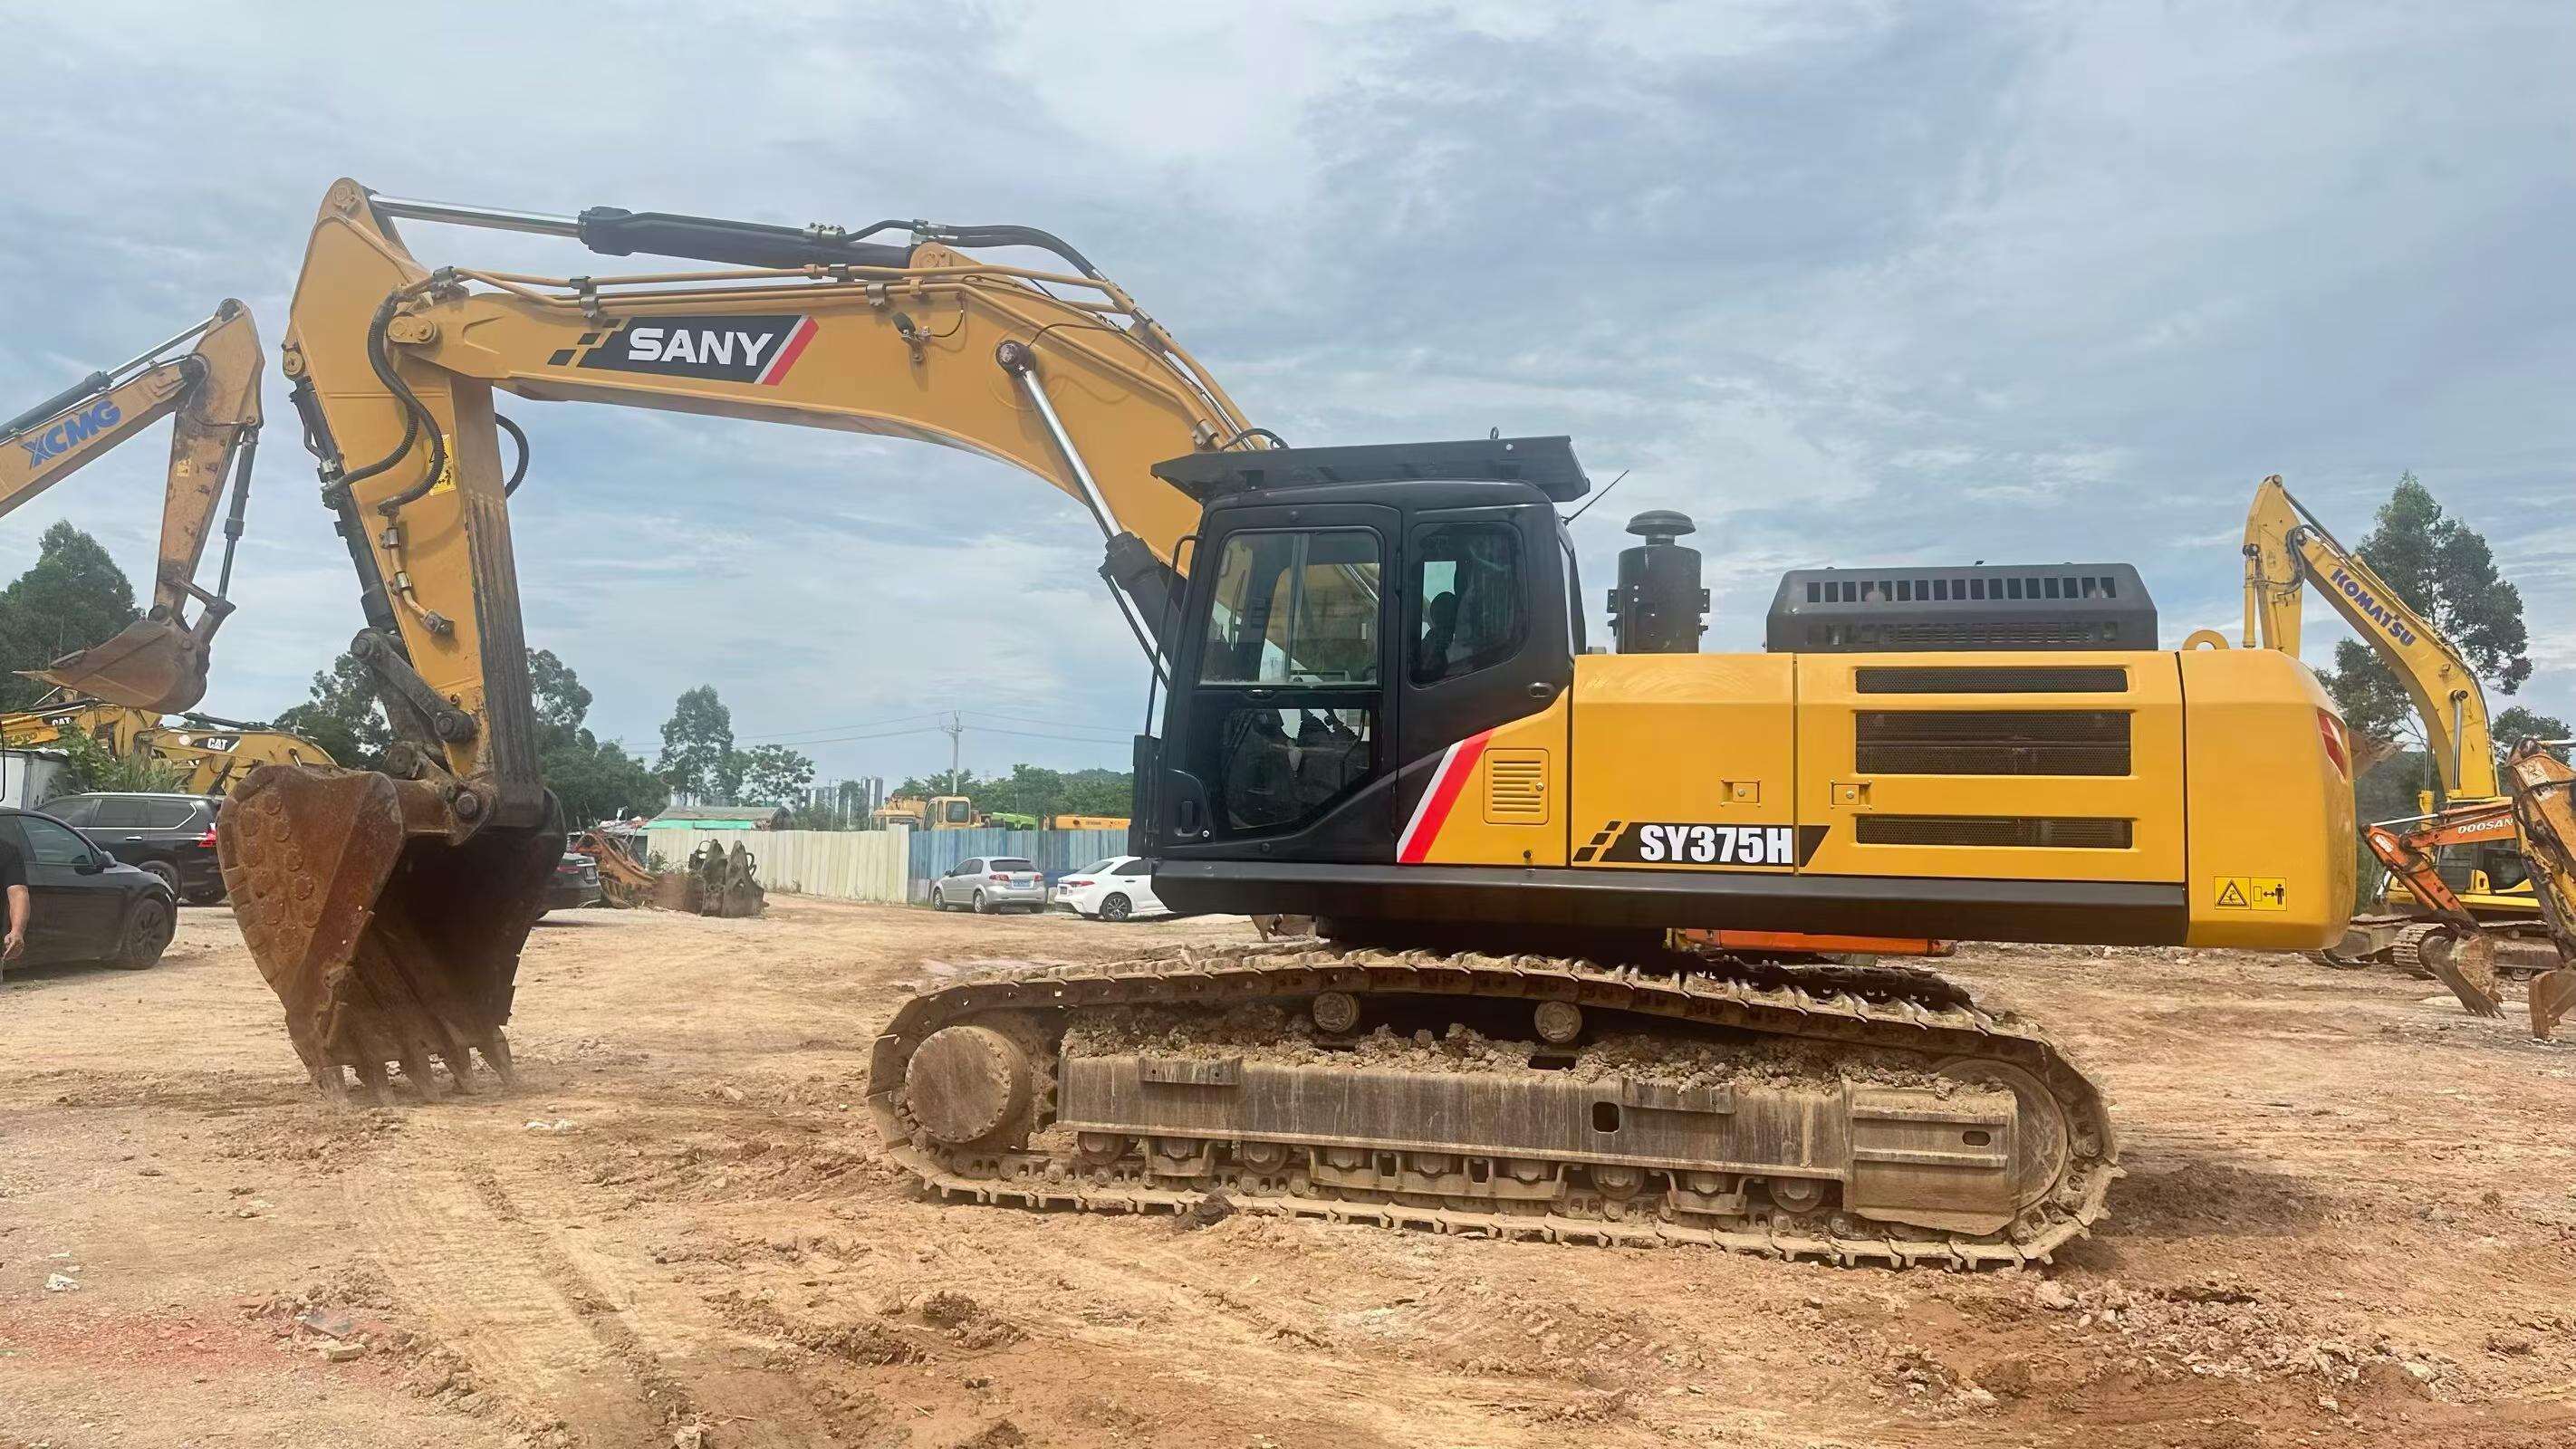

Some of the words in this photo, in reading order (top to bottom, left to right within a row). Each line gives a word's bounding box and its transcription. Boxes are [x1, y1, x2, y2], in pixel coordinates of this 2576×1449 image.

[628, 327, 774, 367] SANY
[21, 398, 121, 470] XCMG
[2330, 567, 2417, 647] KOMATSU
[207, 737, 227, 751] CAT
[1639, 825, 1793, 864] SY375H
[2457, 818, 2514, 834] DOOSAN
